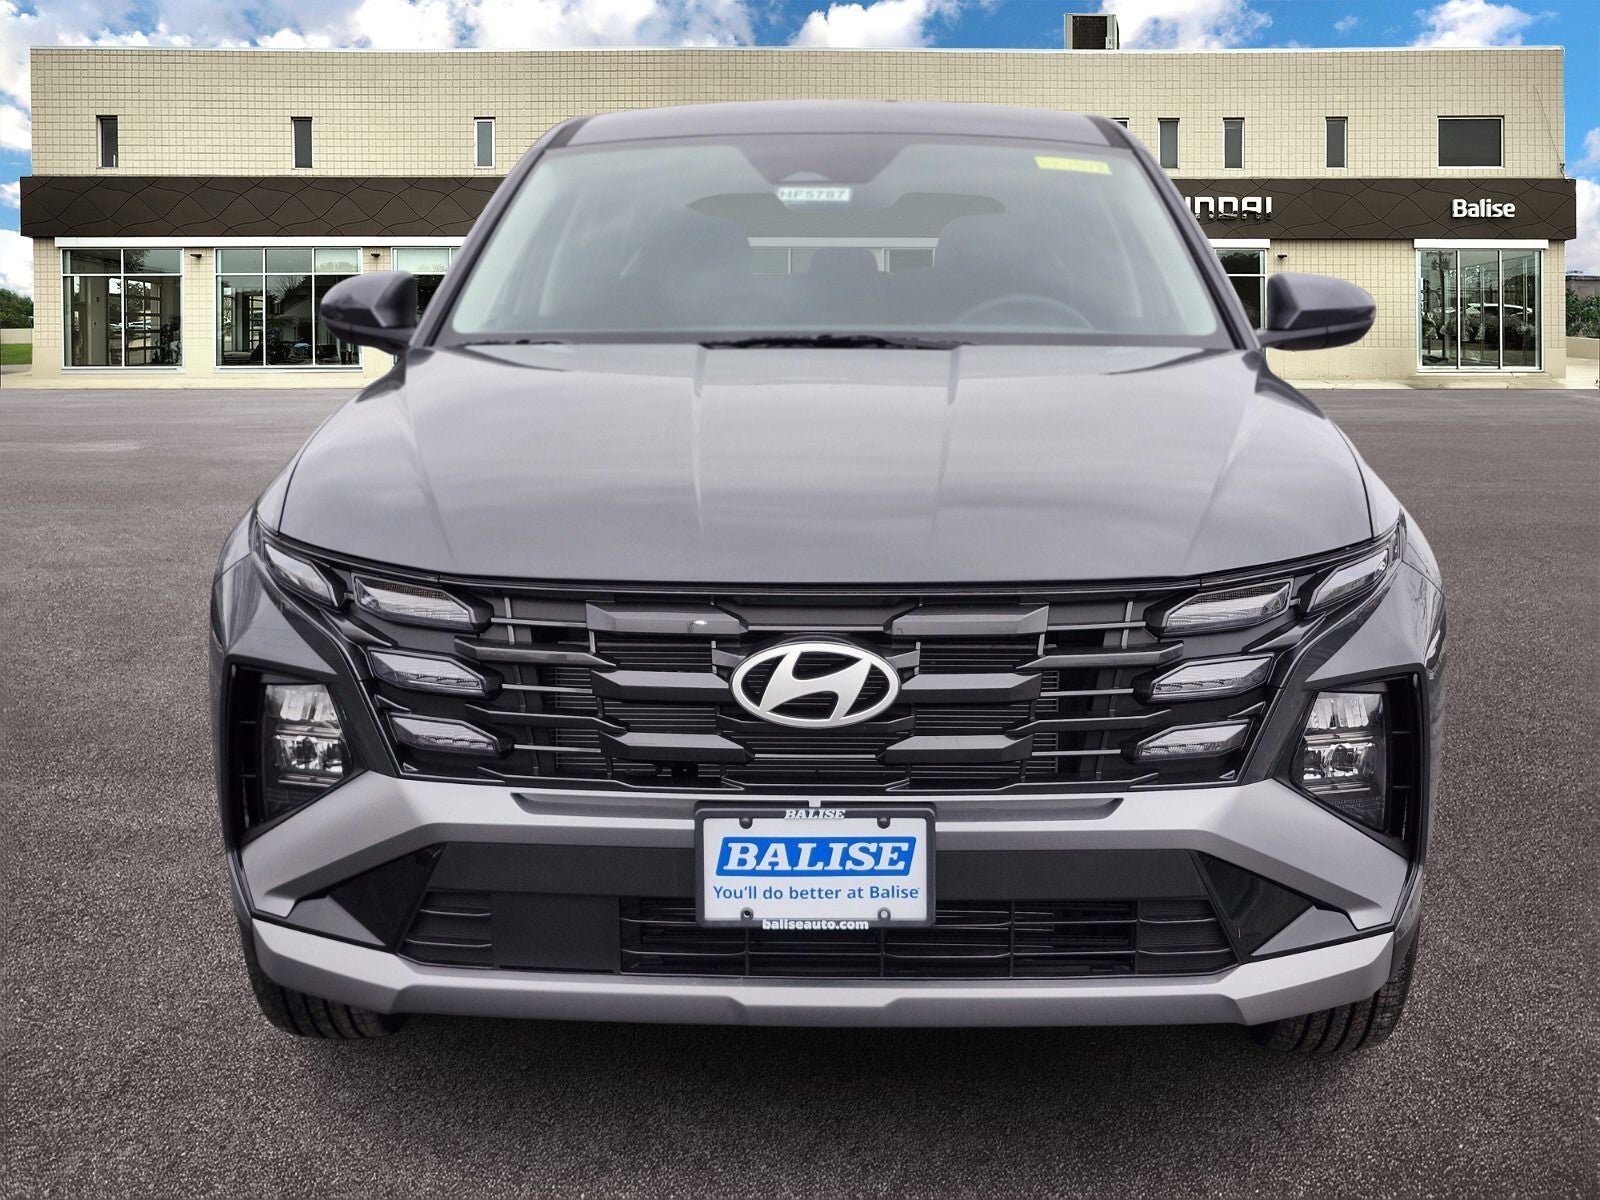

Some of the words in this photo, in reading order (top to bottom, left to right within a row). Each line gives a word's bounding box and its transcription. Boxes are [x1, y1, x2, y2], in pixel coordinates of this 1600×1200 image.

[1452, 198, 1516, 218] Balise
[784, 809, 846, 819] BALISE
[723, 842, 909, 871] BALISE
[713, 885, 757, 900] You'll
[763, 886, 784, 900] do
[789, 886, 842, 900] better
[847, 887, 864, 900] at
[869, 885, 919, 899] Balise
[762, 919, 869, 930] baliseauto.com
